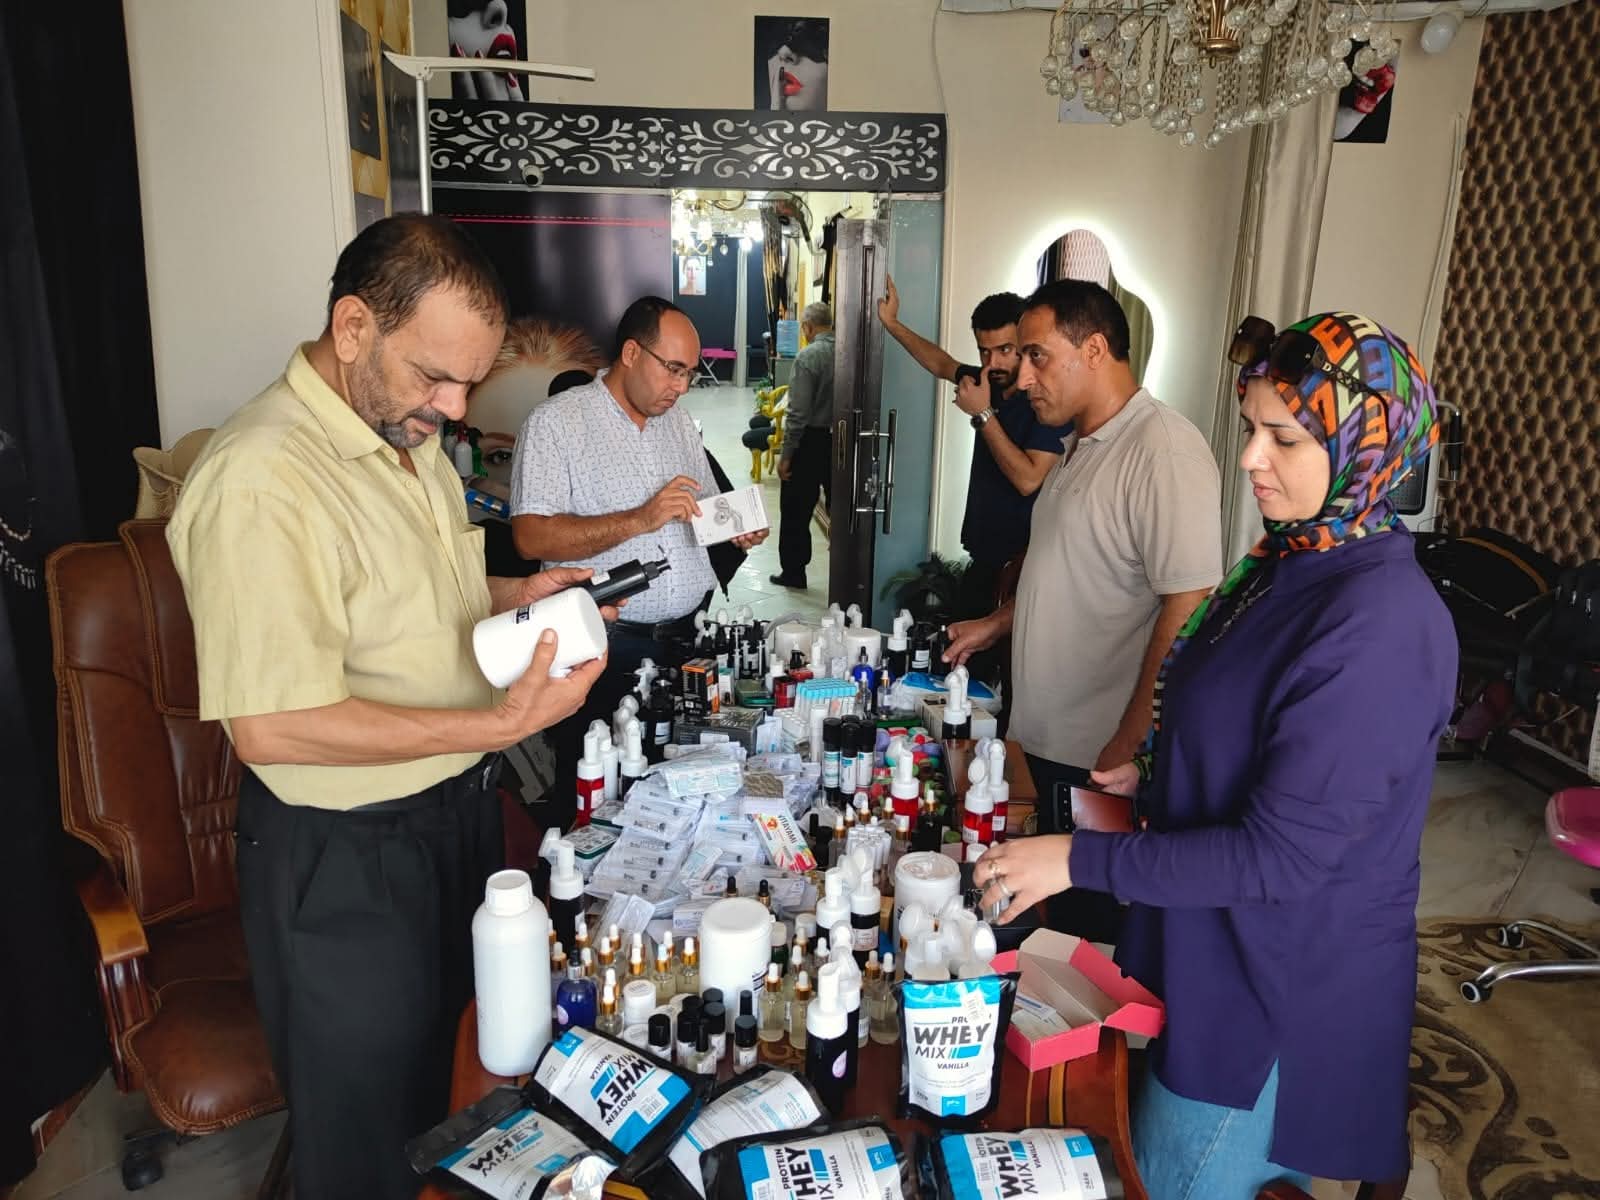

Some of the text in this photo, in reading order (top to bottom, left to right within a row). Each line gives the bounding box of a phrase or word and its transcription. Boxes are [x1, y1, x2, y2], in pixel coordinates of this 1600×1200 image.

[913, 1023, 991, 1046] WHEY
[915, 1046, 946, 1059] MIX
[937, 1062, 969, 1070] VANILLA
[597, 1059, 655, 1120] WHEY
[605, 1090, 637, 1127] PROTEIN
[468, 1121, 539, 1171] WHEY
[482, 1151, 512, 1177] MIX
[774, 1148, 791, 1190] PROTEIN
[784, 1146, 818, 1200] HEY
[828, 1154, 844, 1189] VANILLA
[984, 1136, 1023, 1199] WHEY
[1016, 1162, 1039, 1194] MIX
[817, 1183, 834, 1200] IX
